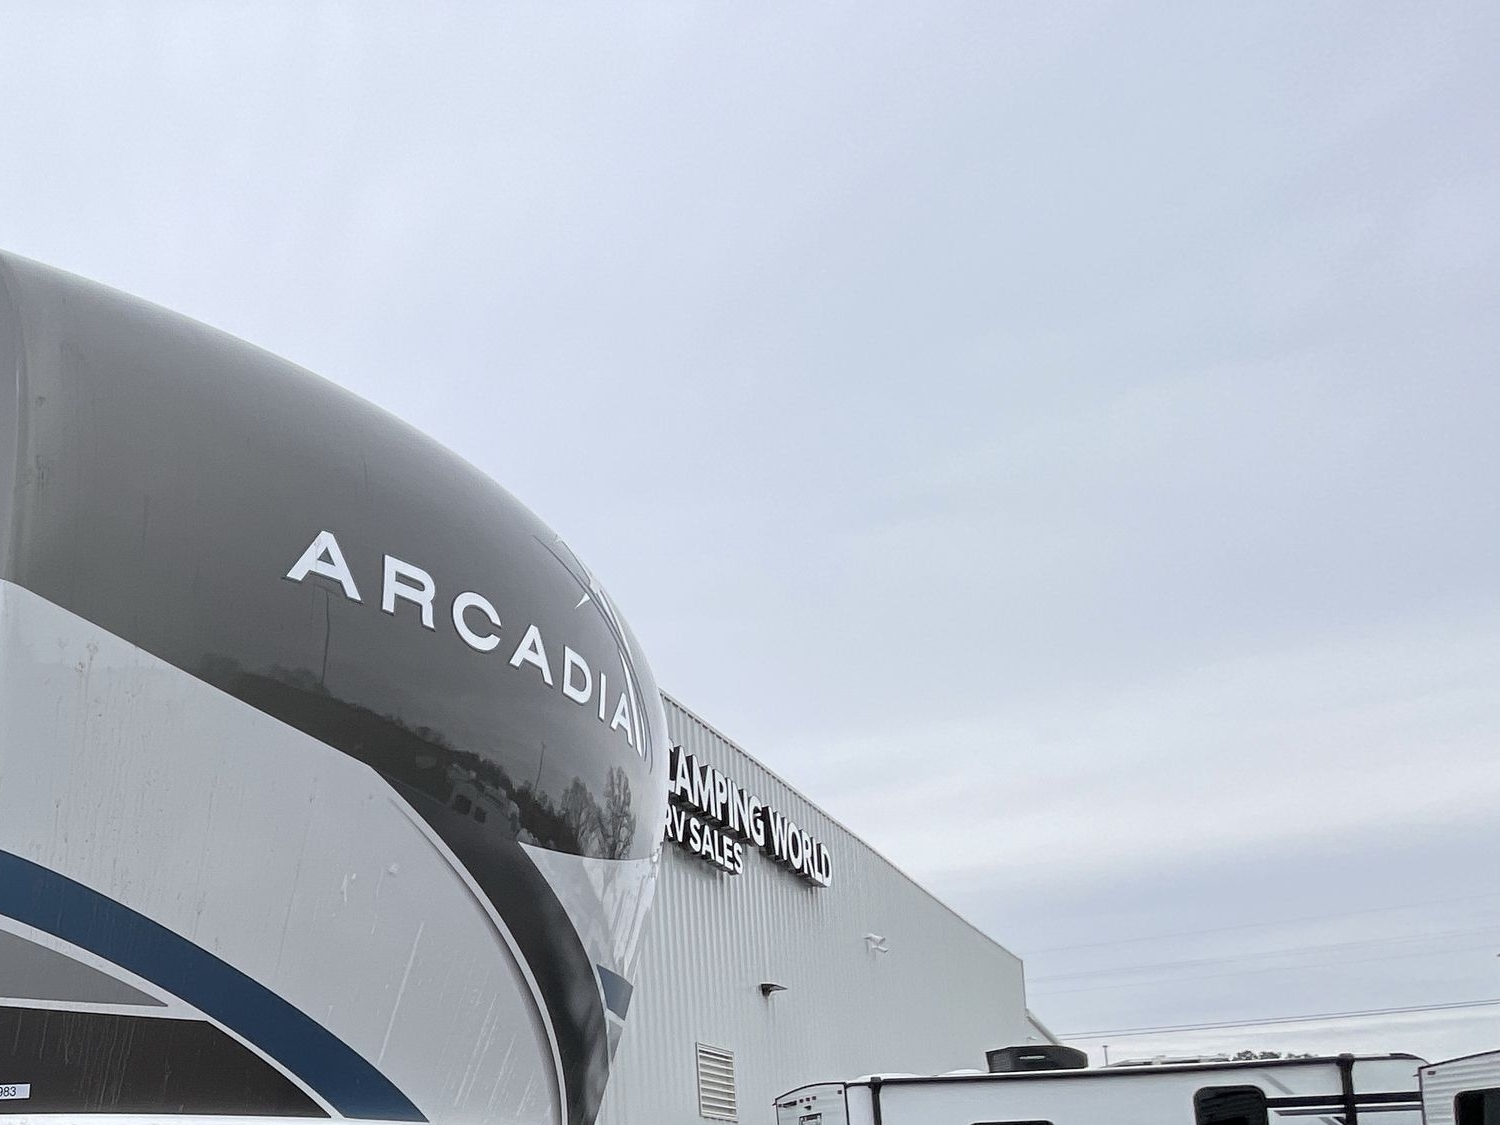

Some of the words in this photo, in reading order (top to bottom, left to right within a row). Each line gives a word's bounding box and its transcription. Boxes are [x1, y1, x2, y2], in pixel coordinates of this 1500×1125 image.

[283, 530, 634, 748] ARCADIA
[664, 804, 685, 842] RV
[689, 817, 743, 875] SALES
[768, 806, 833, 887] WORLD
